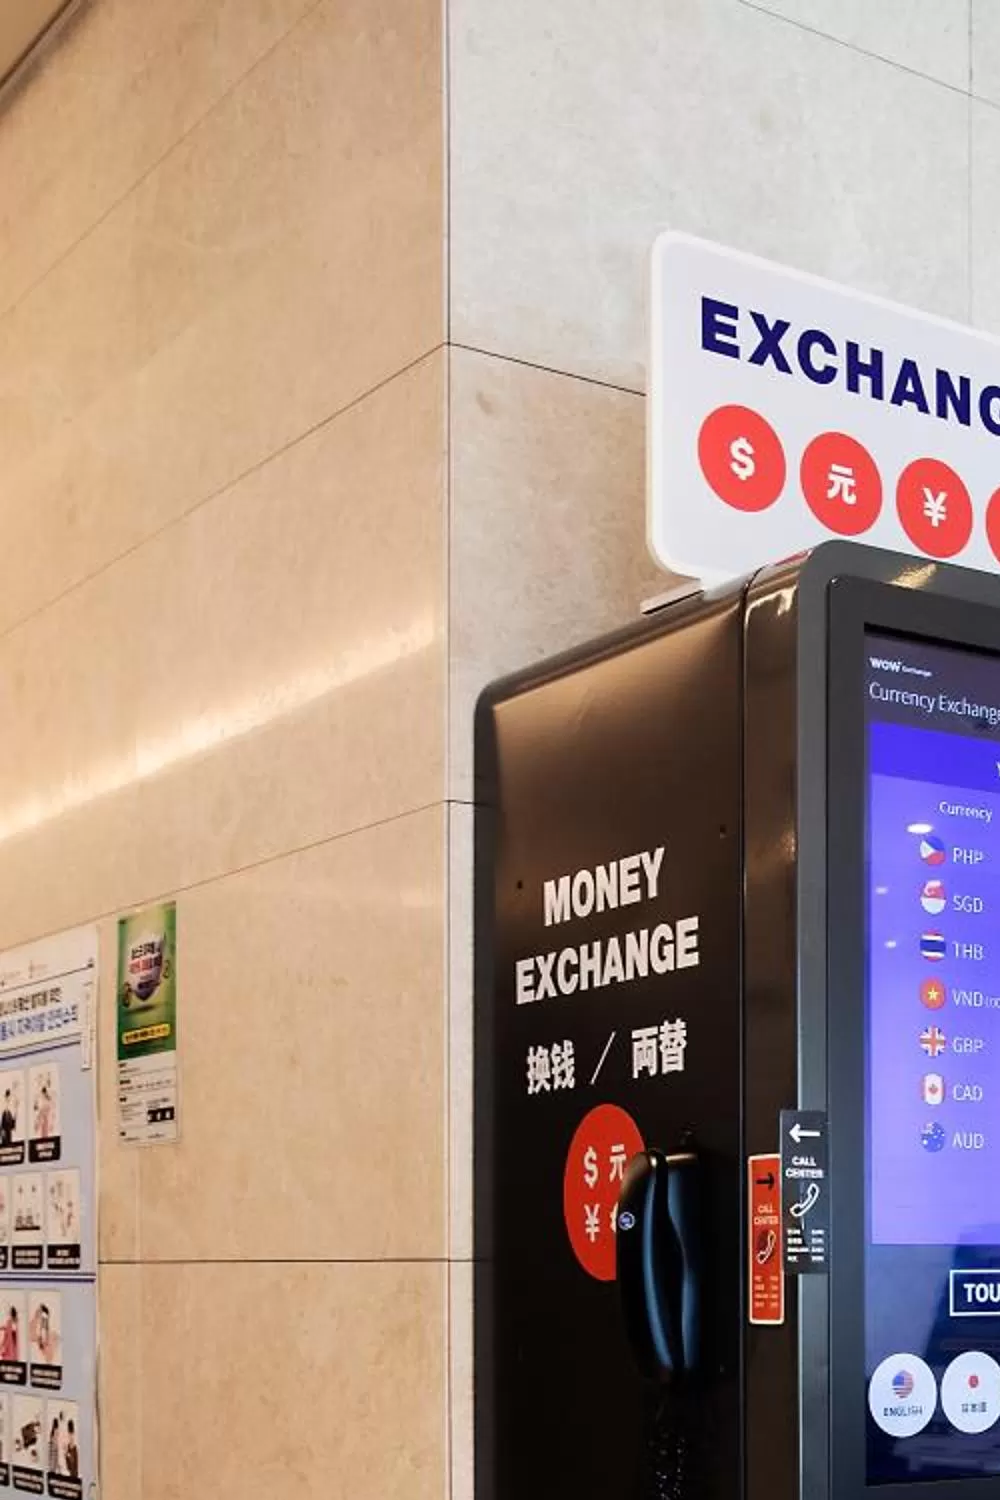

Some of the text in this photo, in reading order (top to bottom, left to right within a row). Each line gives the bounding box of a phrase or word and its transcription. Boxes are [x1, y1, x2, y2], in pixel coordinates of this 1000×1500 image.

[869, 681, 936, 713] Currency
[939, 801, 993, 822] Currency
[952, 847, 984, 866] PHP
[544, 847, 665, 927] MONEY
[952, 895, 984, 914] SGD
[515, 915, 700, 1005] EXCHANGE
[952, 942, 984, 961] THB
[951, 987, 983, 1008] VND
[952, 1036, 984, 1055] GBP
[527, 1039, 576, 1095] 换钱
[631, 1017, 688, 1080] 両替
[952, 1083, 984, 1102] CAD
[952, 1132, 985, 1151] AUD
[792, 1155, 817, 1167] CALL
[785, 1167, 824, 1179] CENTER
[883, 1404, 923, 1417] ENGLISH
